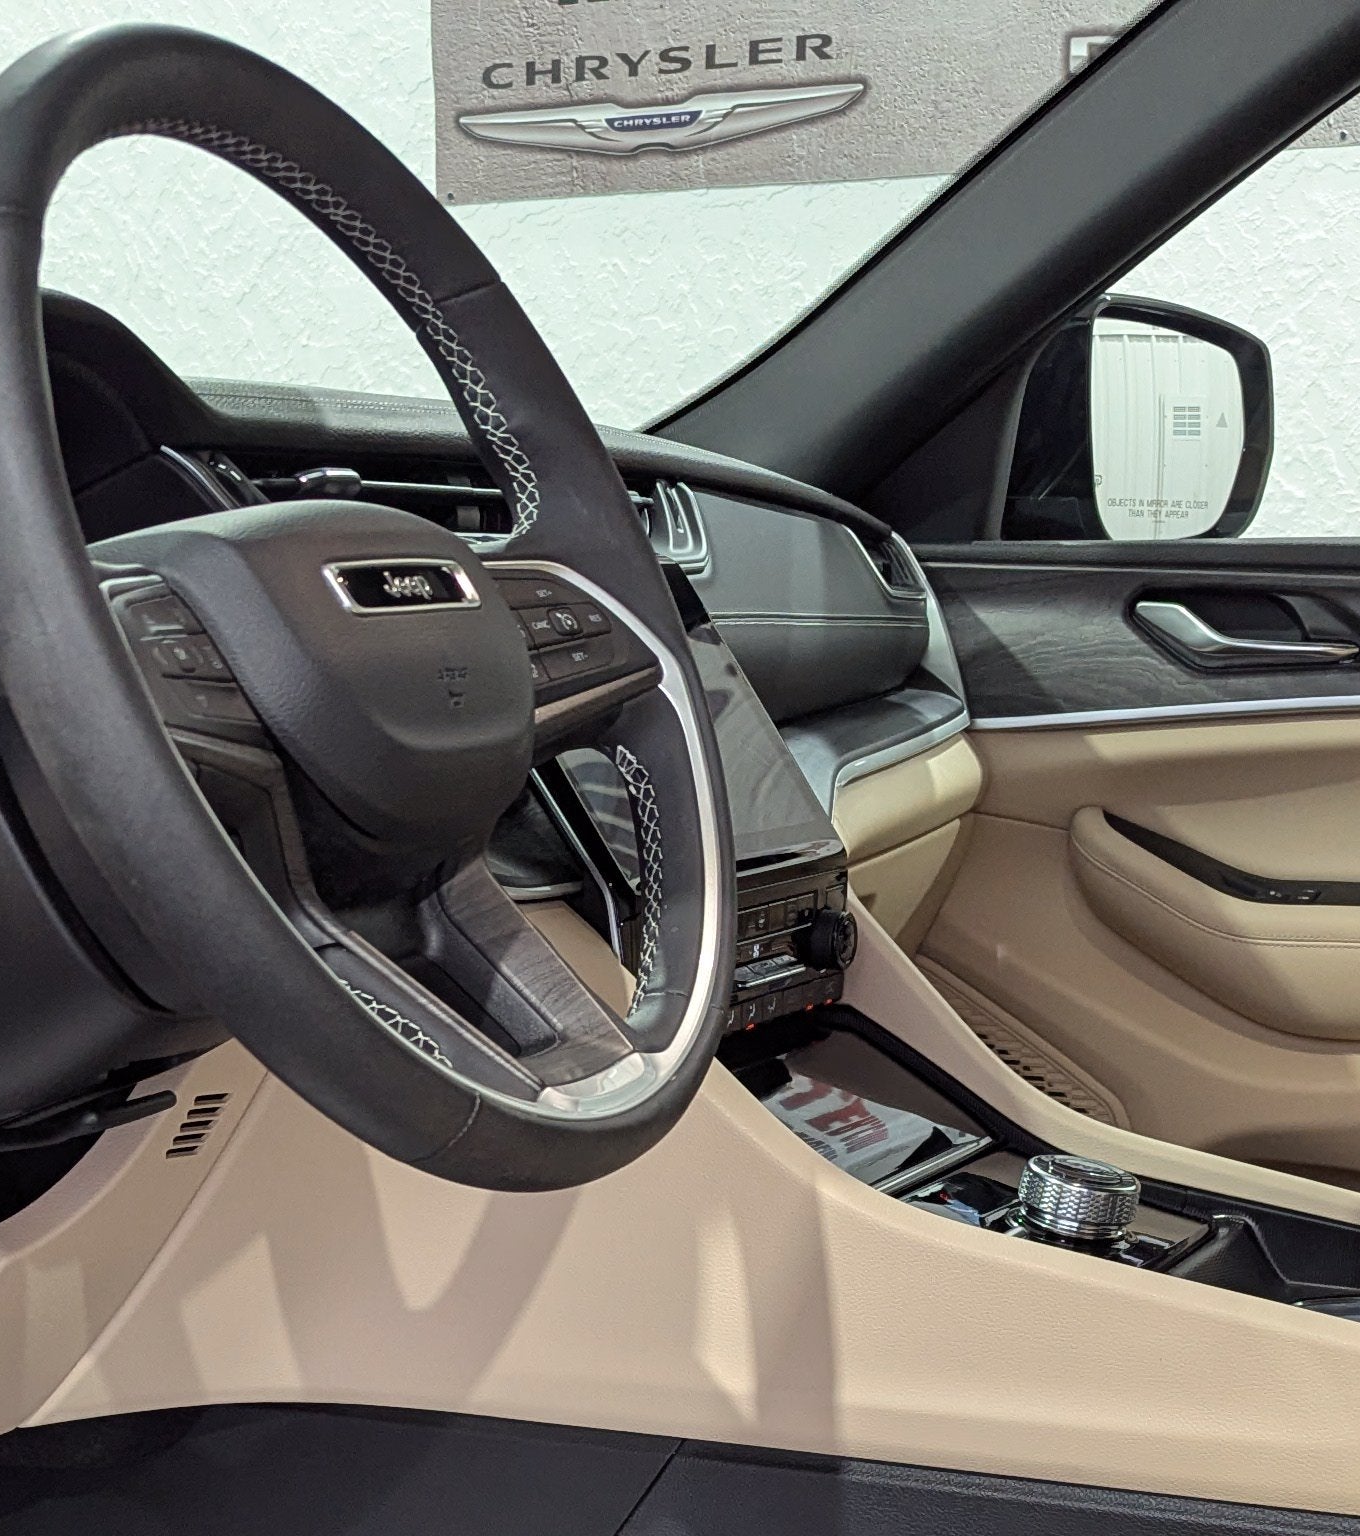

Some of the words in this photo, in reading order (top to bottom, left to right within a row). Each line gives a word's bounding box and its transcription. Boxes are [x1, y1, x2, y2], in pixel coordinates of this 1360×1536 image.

[482, 33, 834, 90] CHRYSLER
[614, 115, 691, 128] CHRYSLER
[1107, 498, 1136, 507] OBJECTS
[1185, 500, 1209, 509] CLOSER
[1128, 509, 1145, 518] THAN
[1164, 510, 1189, 519] APPEAR
